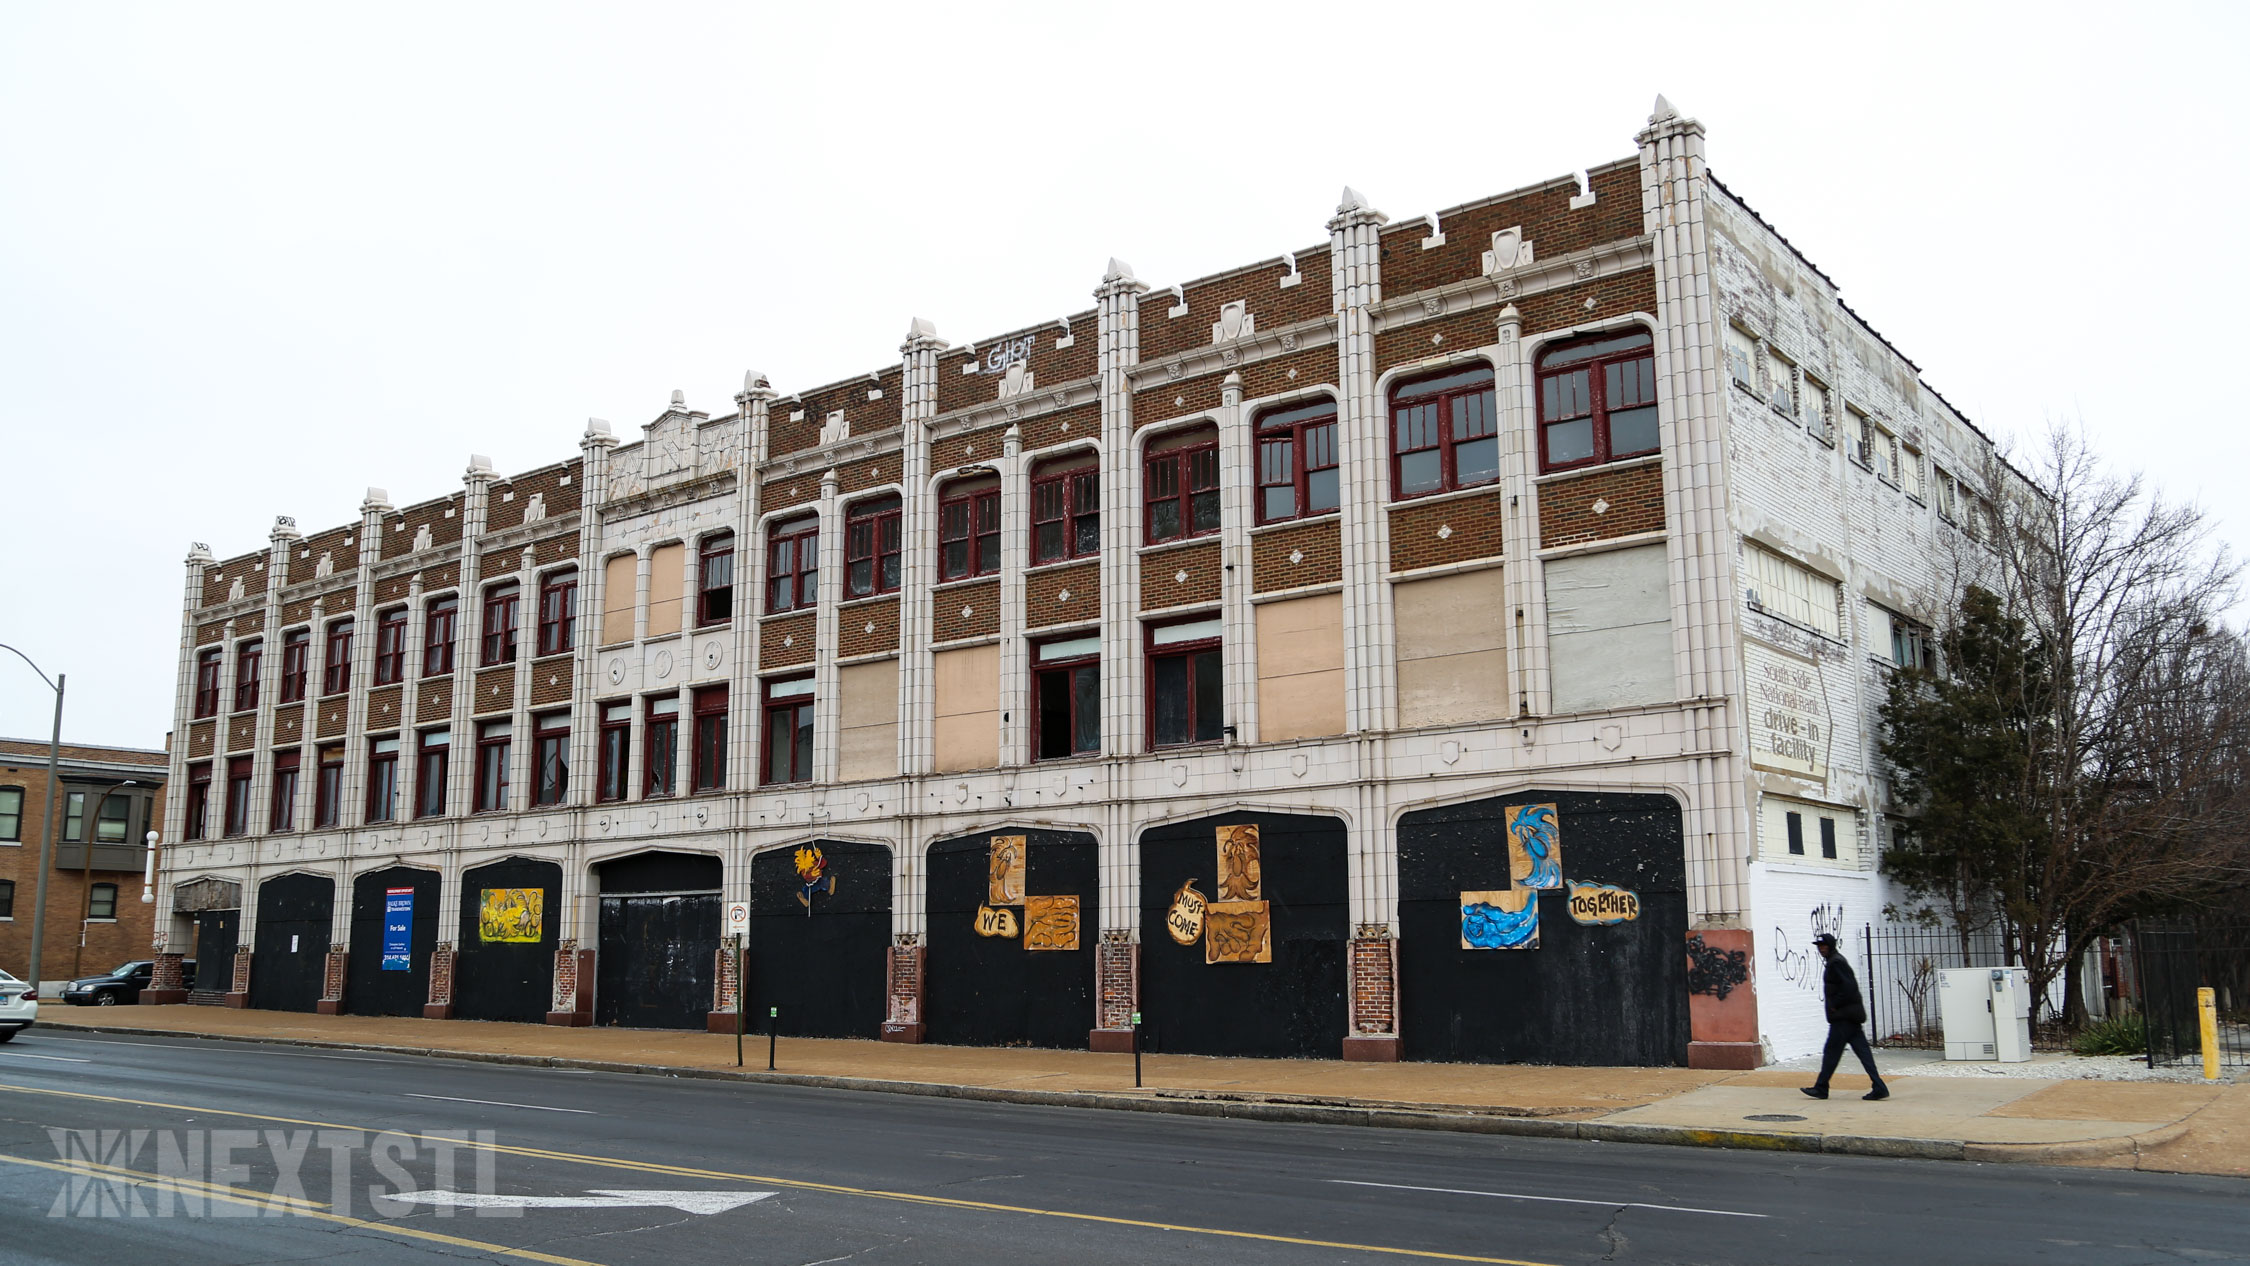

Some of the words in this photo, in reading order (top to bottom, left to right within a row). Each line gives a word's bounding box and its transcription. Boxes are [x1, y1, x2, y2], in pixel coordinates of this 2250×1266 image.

[1177, 893, 1205, 915] MUST
[1570, 890, 1639, 918] TOGETHER
[983, 913, 1008, 932] WE
[1167, 910, 1198, 936] COME
